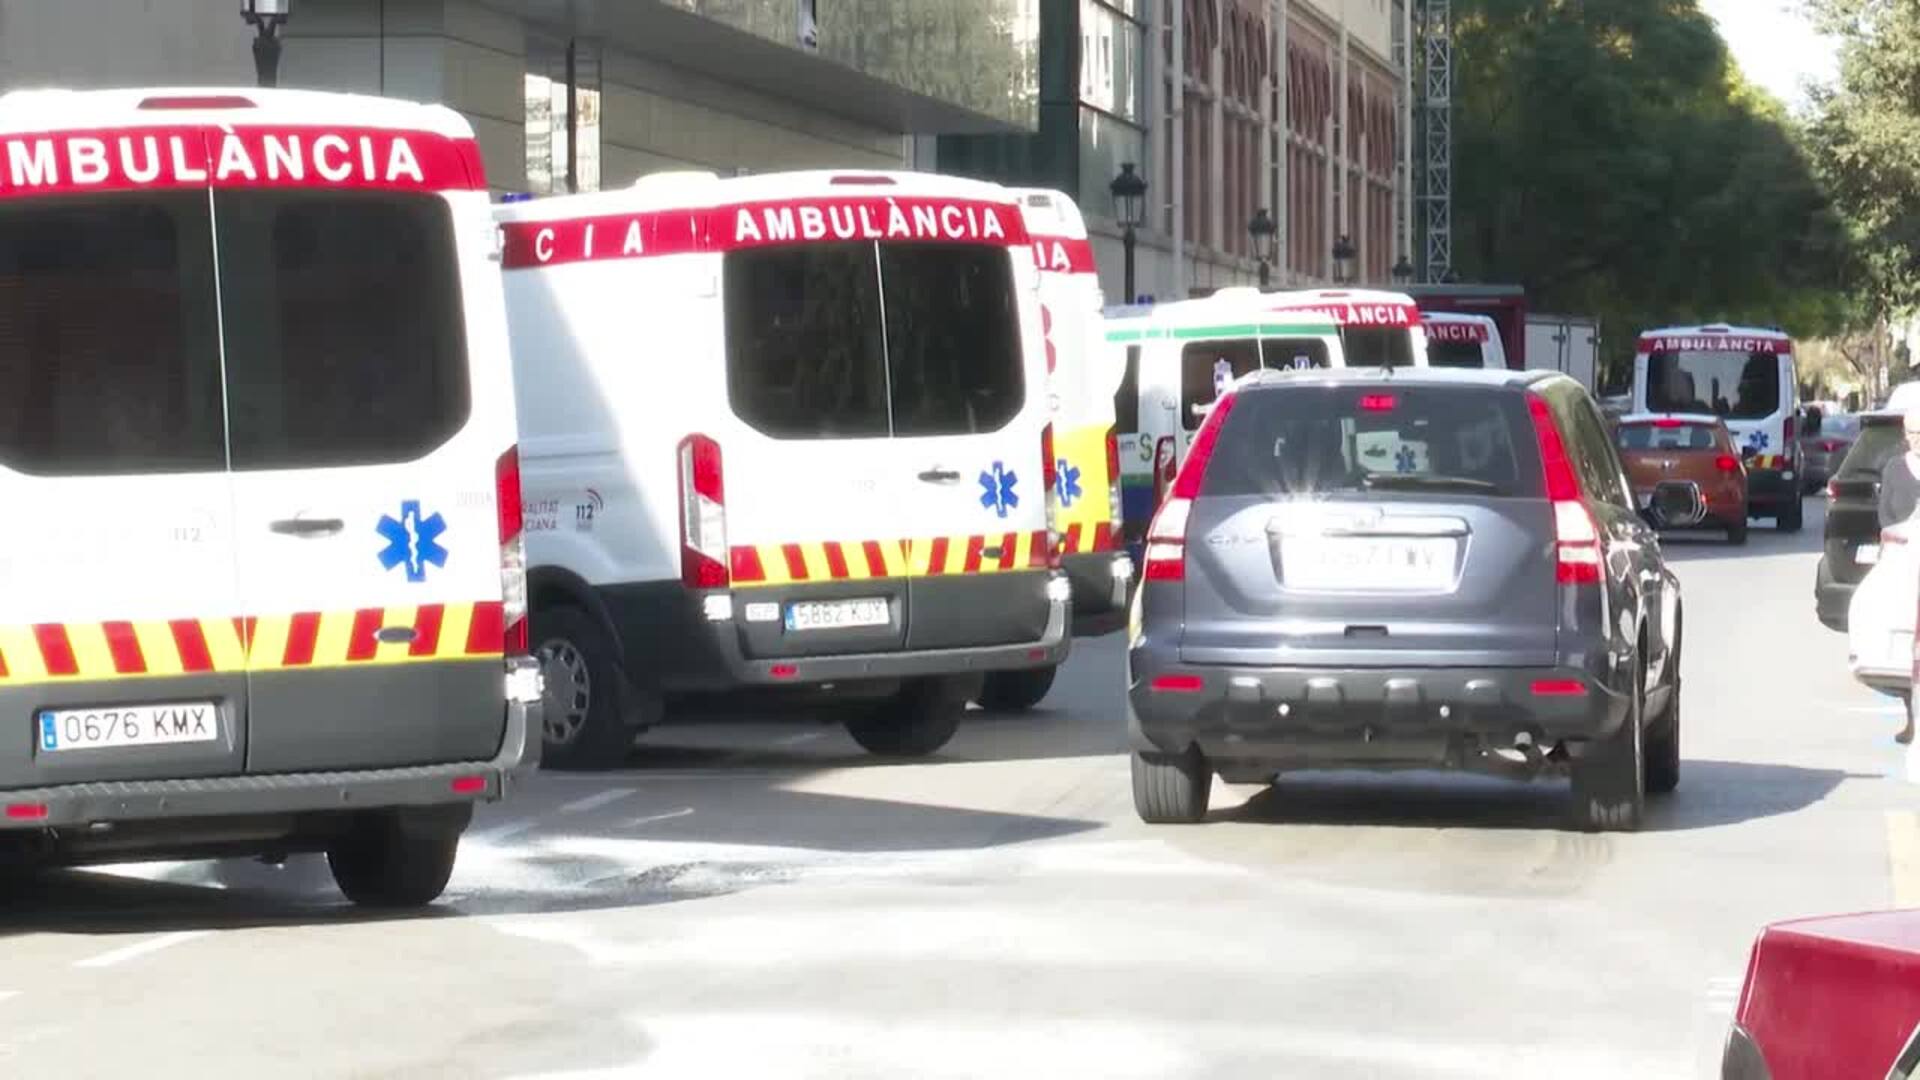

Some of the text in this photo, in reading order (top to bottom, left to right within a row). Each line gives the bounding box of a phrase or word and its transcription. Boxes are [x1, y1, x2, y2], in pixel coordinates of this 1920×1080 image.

[734, 199, 1005, 242] AMBULÀNCIA
[1653, 337, 1774, 351] AMBULÀNCIA
[576, 504, 595, 520] 112
[65, 708, 207, 743] 0676 KMX
